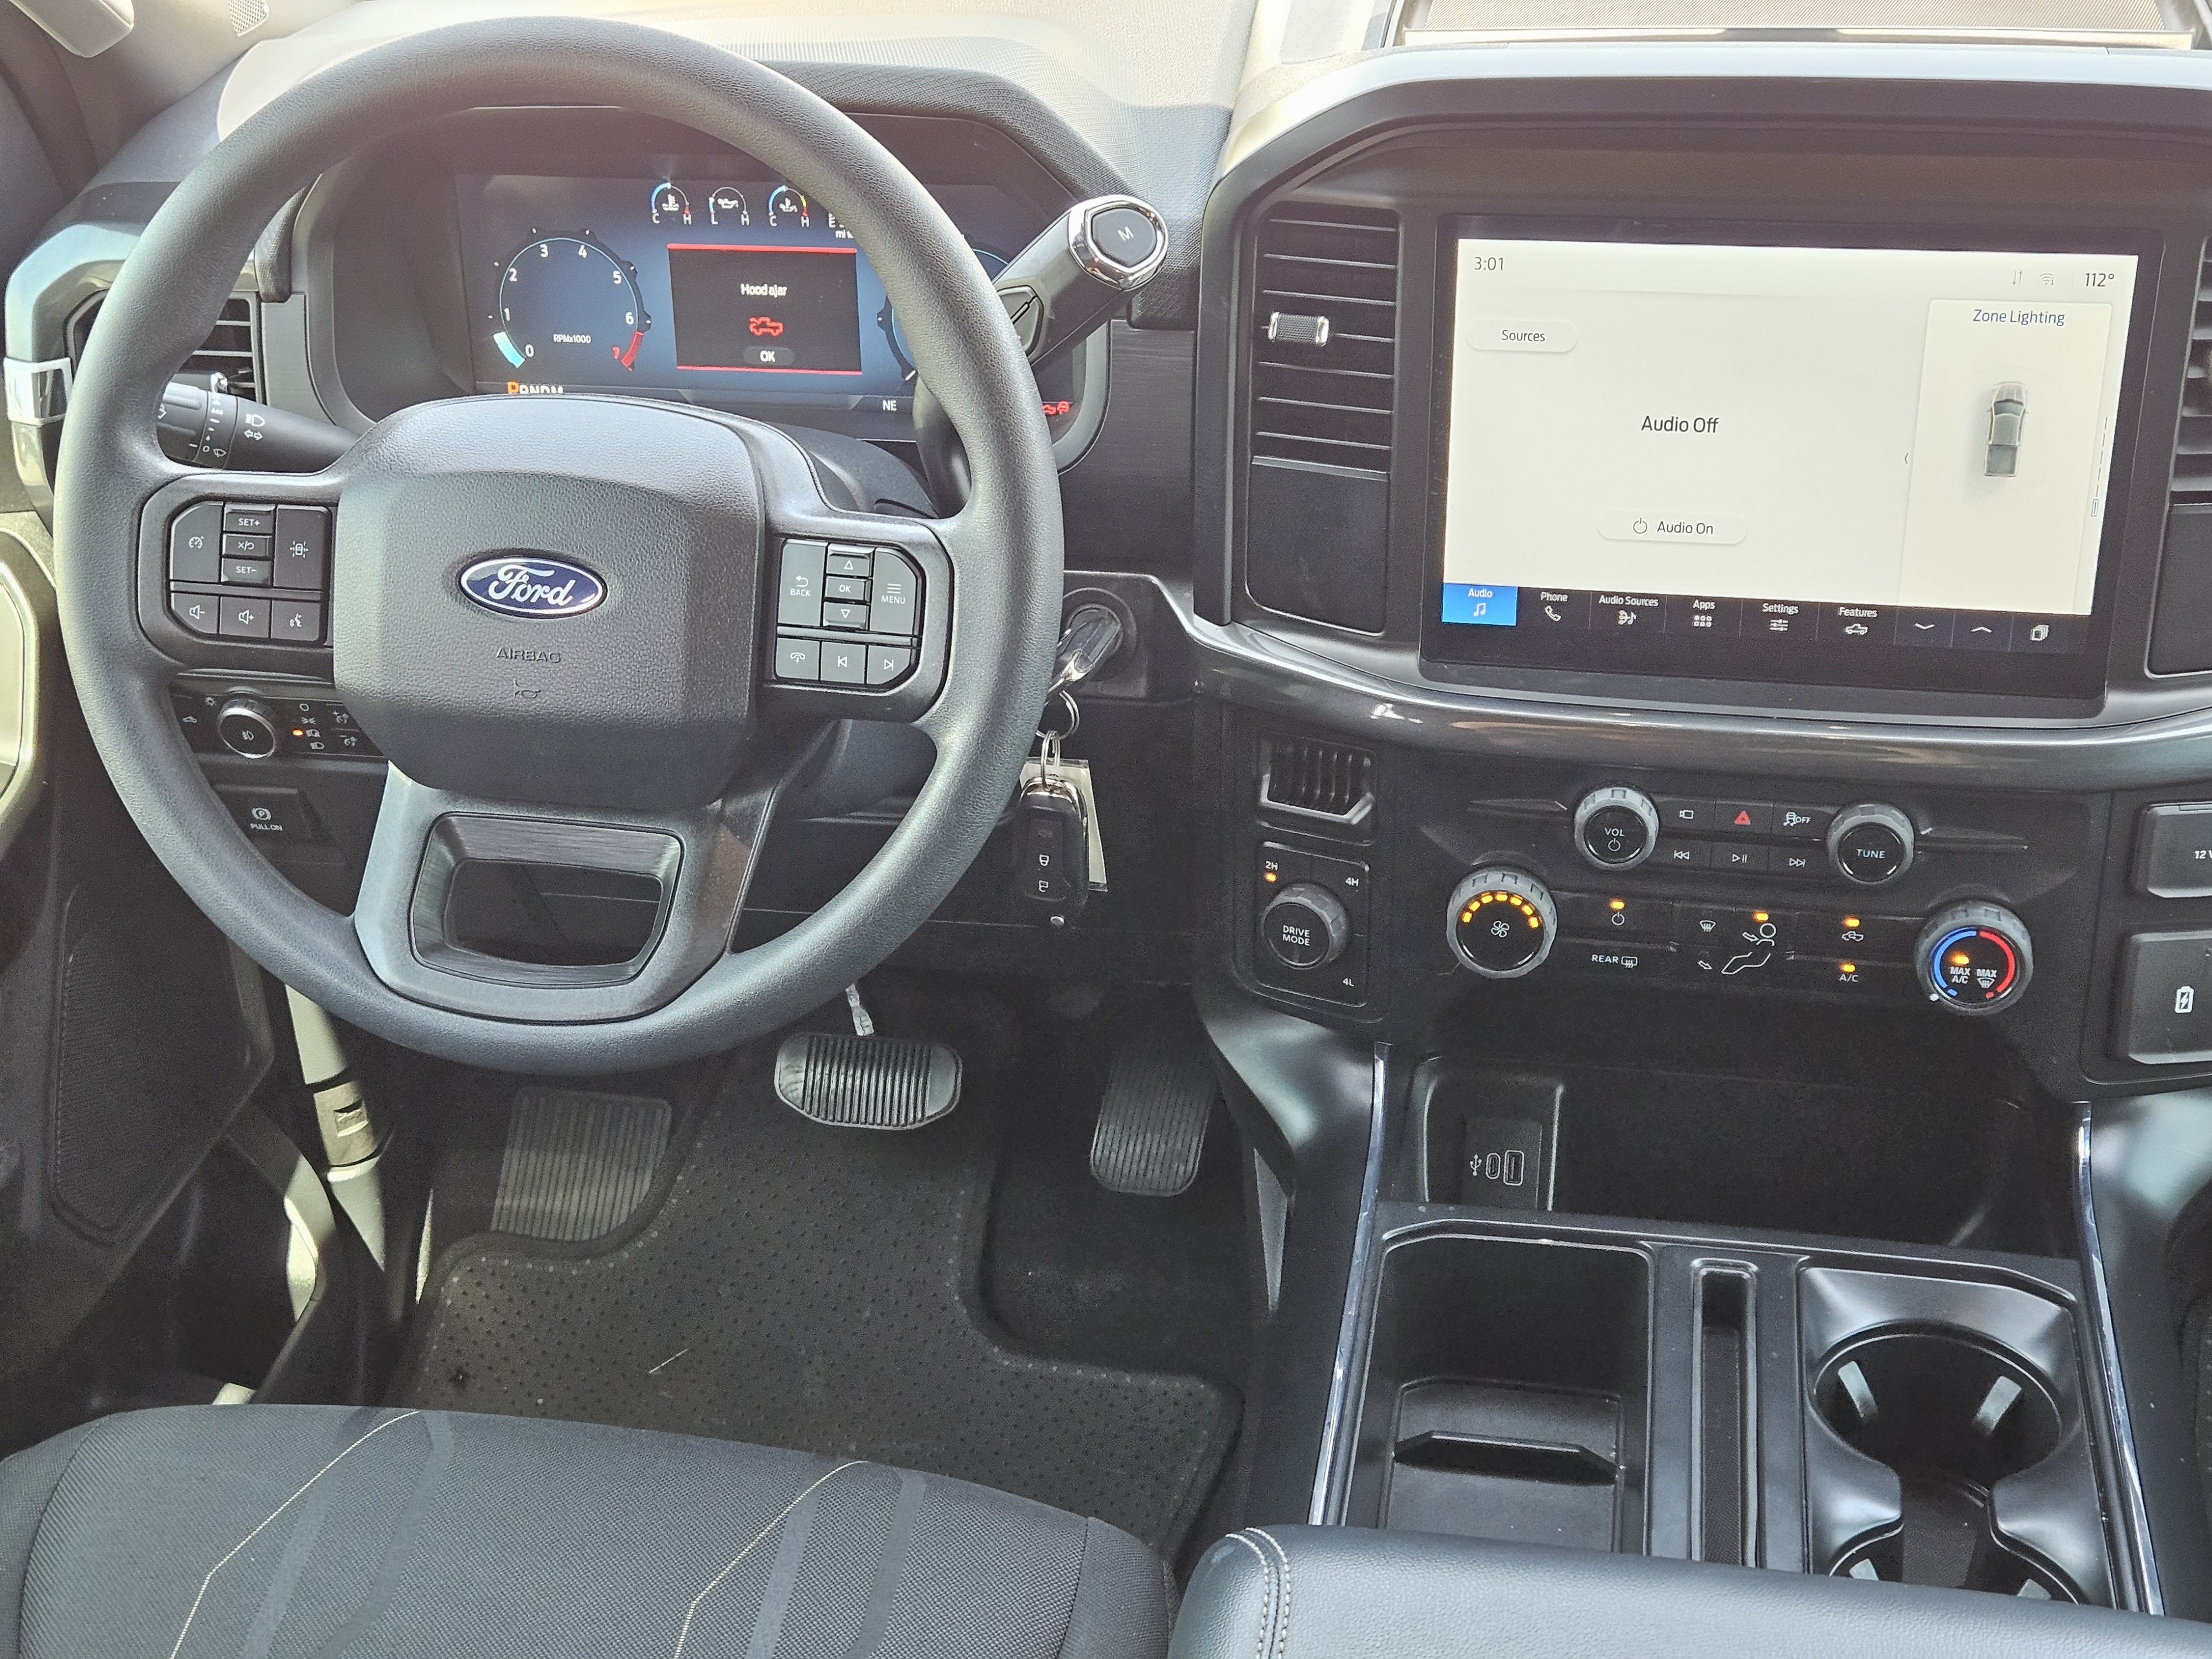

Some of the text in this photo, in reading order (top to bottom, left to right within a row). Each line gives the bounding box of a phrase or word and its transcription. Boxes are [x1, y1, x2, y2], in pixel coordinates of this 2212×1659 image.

[652, 213, 660, 224] C
[684, 213, 692, 225] H
[711, 213, 718, 225] L
[741, 214, 749, 226] H
[769, 215, 777, 227] C
[801, 216, 810, 227] H
[540, 244, 549, 258] 3
[578, 244, 587, 258] 4
[1474, 256, 1505, 271] 3:01
[509, 268, 518, 281] 2
[613, 271, 622, 284] 5
[2084, 272, 2115, 287] 112°
[740, 284, 787, 298] Hood ajar
[504, 308, 510, 321] 1
[625, 312, 634, 325] 6
[1973, 309, 2065, 326] Zone Lighting
[553, 334, 591, 344] RPMx1000
[1501, 330, 1546, 343] Sources
[525, 345, 534, 357] 0
[612, 347, 620, 359] 7
[760, 350, 776, 362] OK
[883, 400, 897, 411] NE
[1641, 416, 1719, 433] Audio Off
[1657, 521, 1713, 535] Audio On
[488, 564, 576, 606] Ford
[839, 585, 851, 593] OK
[790, 588, 811, 597] BACK
[1468, 588, 1493, 598] Audio
[1541, 592, 1568, 602] Phone
[881, 595, 906, 604] MENU
[1599, 594, 1658, 607] Audio Sources
[1693, 599, 1715, 610] Apps
[1762, 603, 1799, 615] Settings
[1839, 607, 1877, 618] Features
[496, 647, 561, 663] AIRBAG
[1605, 828, 1625, 837] VOL
[1856, 848, 1886, 859] TUNE
[2194, 850, 2206, 859] 12
[1265, 860, 1278, 870] 2H
[1345, 878, 1359, 886] 4H
[1283, 925, 1310, 938] DRIVE
[1282, 934, 1310, 946] MODE
[1592, 954, 1618, 964] REAR
[1950, 967, 1970, 976] MAX
[1976, 969, 1997, 978] MAX
[1343, 978, 1354, 987] 4L
[1952, 975, 1968, 984] A/C
